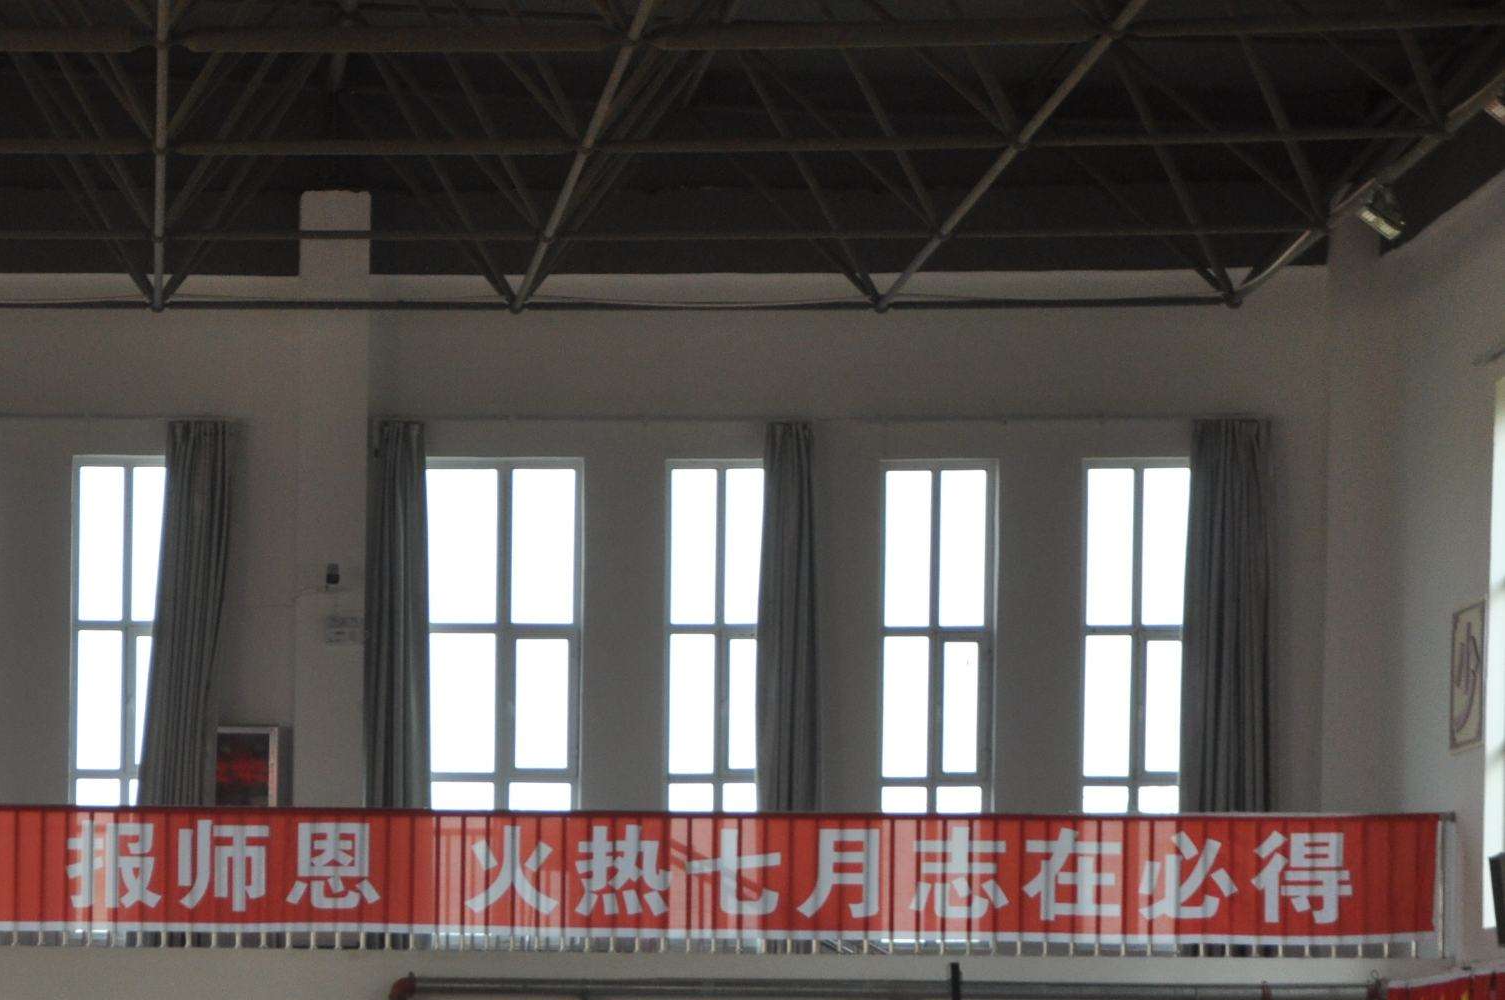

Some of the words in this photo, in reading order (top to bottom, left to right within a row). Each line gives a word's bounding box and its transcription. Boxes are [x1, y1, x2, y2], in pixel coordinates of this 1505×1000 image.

[66, 818, 381, 913] 报师恩
[464, 823, 1353, 924] 火热七月志在必得
